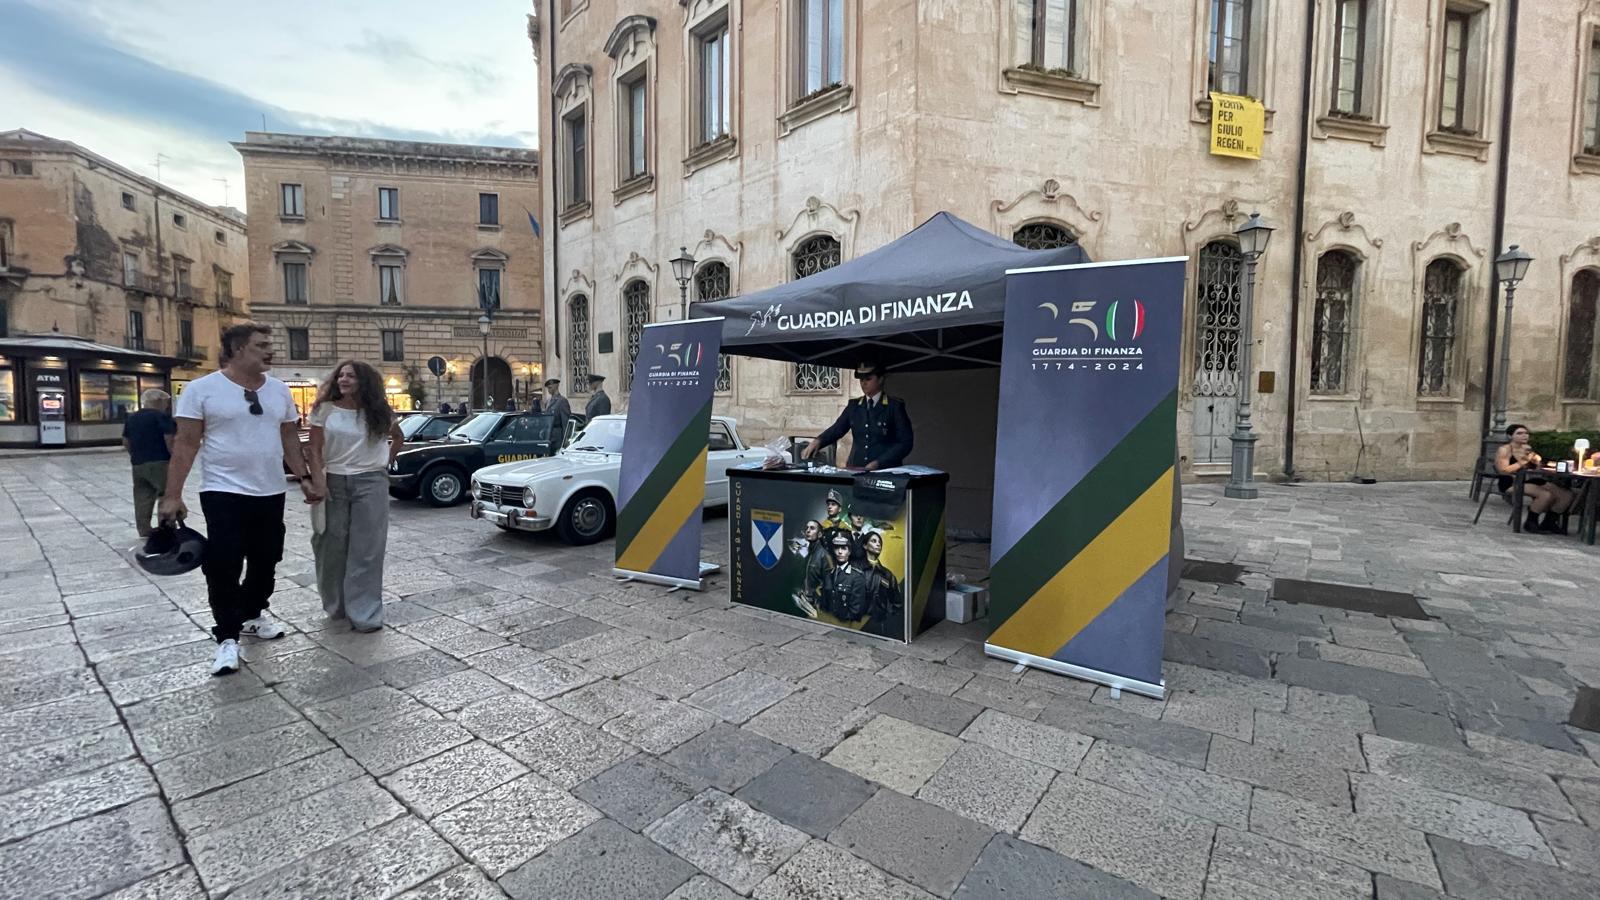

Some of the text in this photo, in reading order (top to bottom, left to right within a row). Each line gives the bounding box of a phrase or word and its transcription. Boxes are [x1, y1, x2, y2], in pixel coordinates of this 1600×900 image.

[1218, 111, 1234, 122] PER
[1217, 124, 1243, 136] GIULIO
[1216, 136, 1244, 150] REGENI
[777, 290, 974, 330] GUARDIA DI FINANZA
[1032, 347, 1143, 356] GUARDIA DI FINANZA
[36, 374, 60, 382] ATM
[497, 453, 538, 463] GUARDIA
